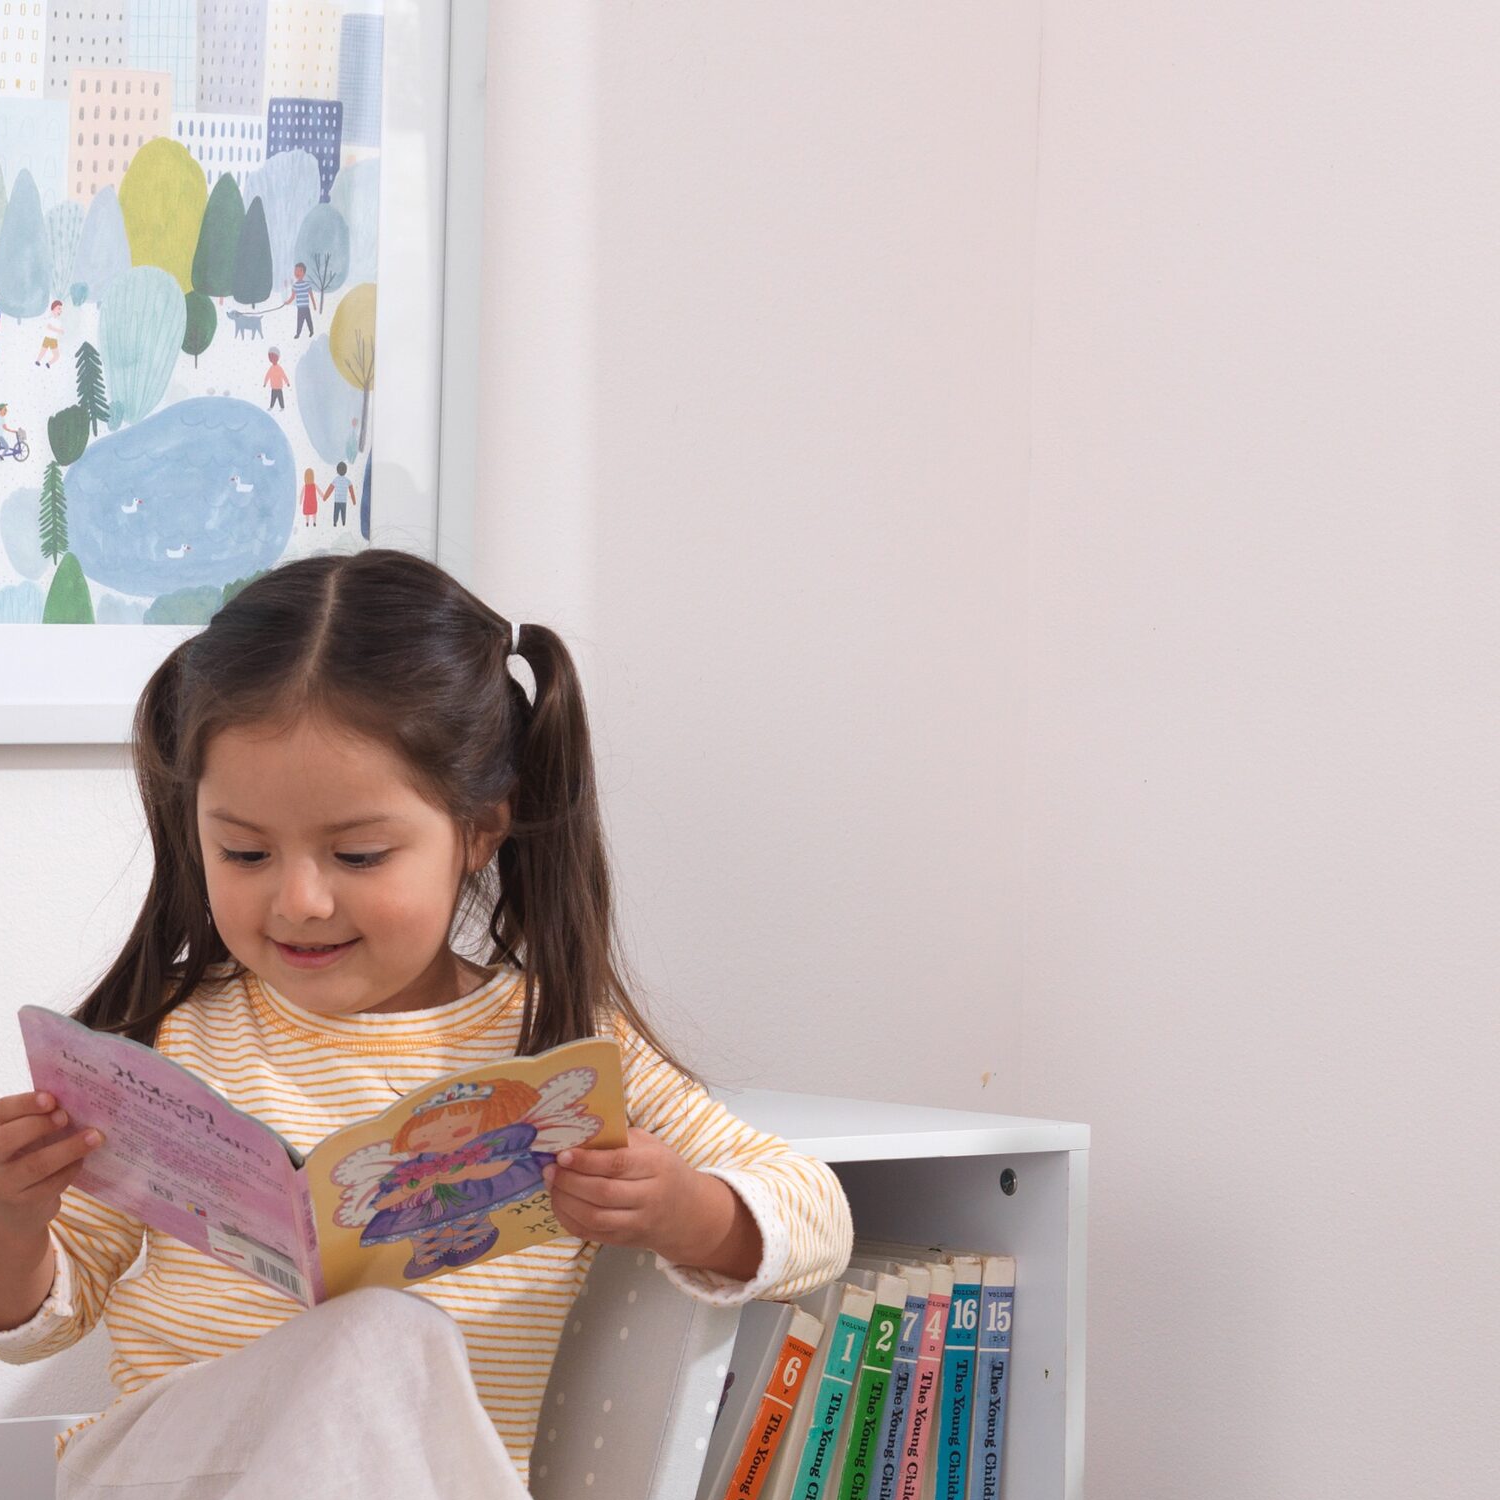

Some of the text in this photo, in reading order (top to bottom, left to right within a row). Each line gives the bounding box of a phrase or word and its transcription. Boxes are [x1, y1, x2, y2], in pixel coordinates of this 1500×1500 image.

[904, 1312, 919, 1341] 7
[925, 1310, 942, 1340] 4
[952, 1299, 977, 1330] 16
[986, 1302, 1011, 1332] 15
[842, 1332, 855, 1362] 1
[876, 1320, 894, 1351] 2
[783, 1357, 802, 1387] 6
[894, 1371, 910, 1406] The
[918, 1371, 933, 1404] The
[954, 1360, 969, 1393] The
[990, 1361, 1004, 1395] The
[825, 1392, 844, 1425] The
[867, 1381, 884, 1415] The
[761, 1414, 783, 1444] The
[884, 1409, 904, 1459] Young
[907, 1407, 927, 1458] Young
[948, 1396, 965, 1447] Young
[984, 1397, 1001, 1449] Young
[810, 1428, 835, 1479] Young
[854, 1417, 877, 1469] Young
[740, 1447, 769, 1496] Young
